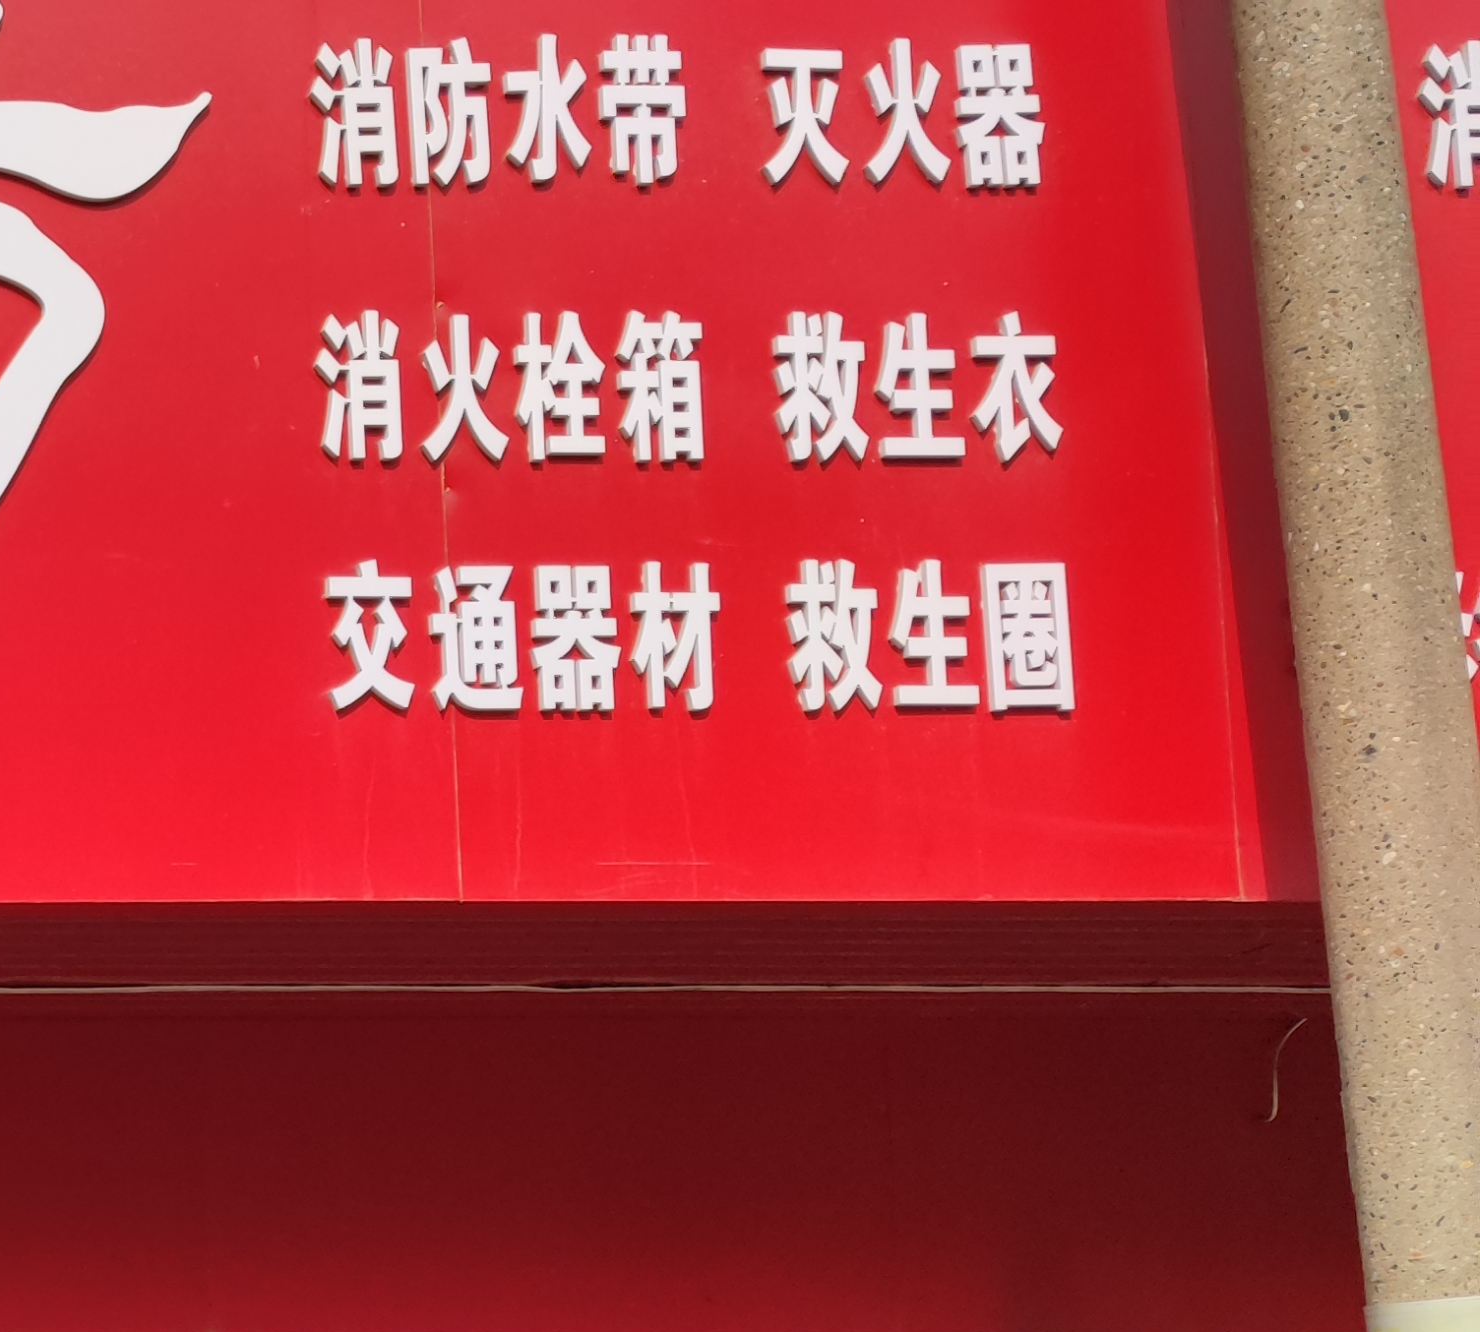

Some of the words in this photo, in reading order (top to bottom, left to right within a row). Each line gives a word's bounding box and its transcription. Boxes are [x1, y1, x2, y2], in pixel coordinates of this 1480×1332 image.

[309, 32, 688, 188] 消防水带
[760, 38, 1047, 188] 灭火器
[314, 308, 706, 463] 消火栓箱
[771, 310, 1065, 463] 救生衣
[322, 559, 722, 713] 交通器材
[784, 559, 1077, 713] 救生圈
